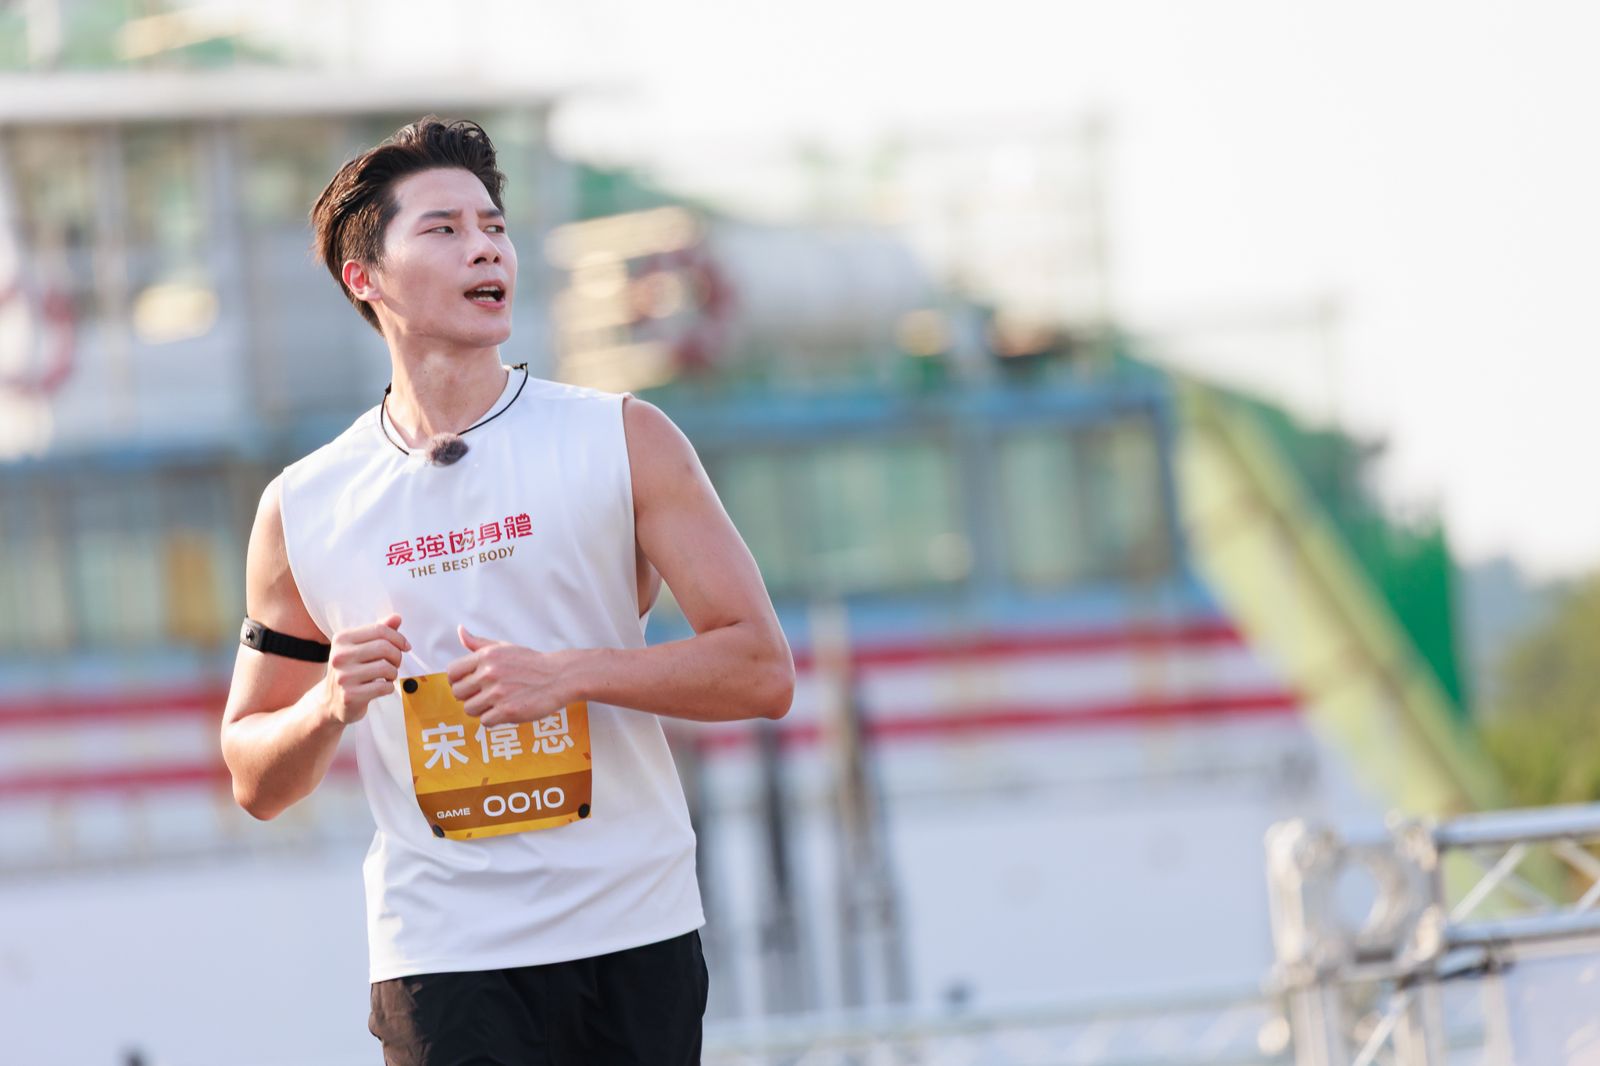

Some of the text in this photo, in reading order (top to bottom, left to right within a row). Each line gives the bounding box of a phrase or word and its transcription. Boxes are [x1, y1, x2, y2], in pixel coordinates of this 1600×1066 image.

[385, 512, 534, 567] 最強的身體
[408, 545, 515, 579] THE BEST BODY
[421, 706, 575, 770] 宋偉恩
[436, 786, 565, 819] GAME 0010
